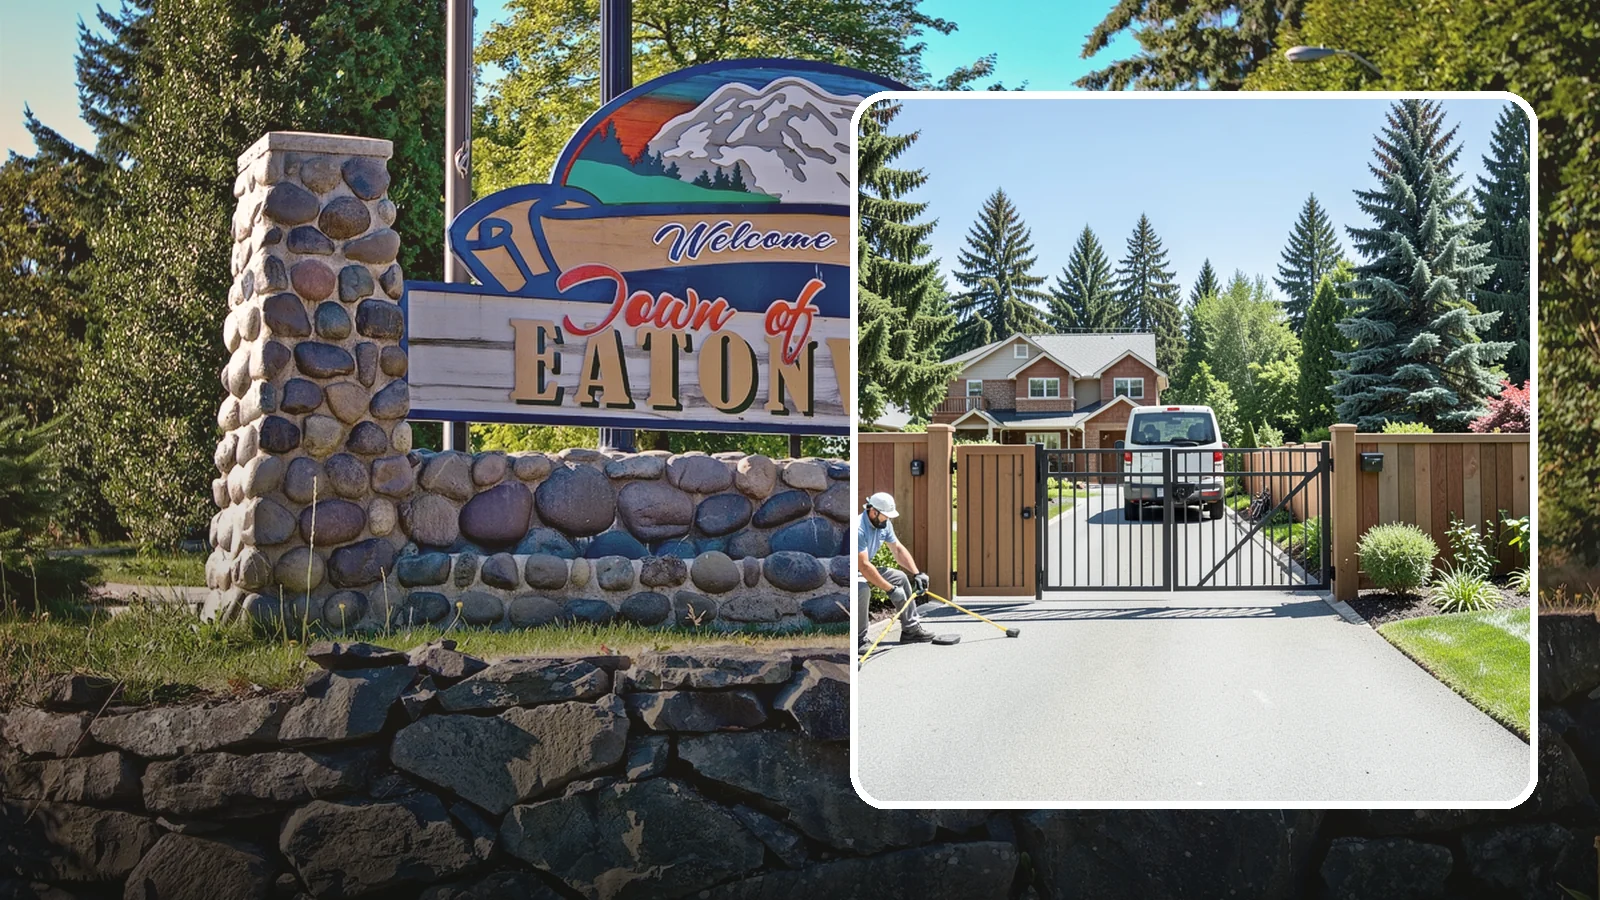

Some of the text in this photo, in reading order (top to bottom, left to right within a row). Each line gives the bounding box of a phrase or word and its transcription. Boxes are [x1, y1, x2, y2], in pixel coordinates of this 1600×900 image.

[653, 221, 837, 264] Welcome
[557, 263, 826, 365] Town of
